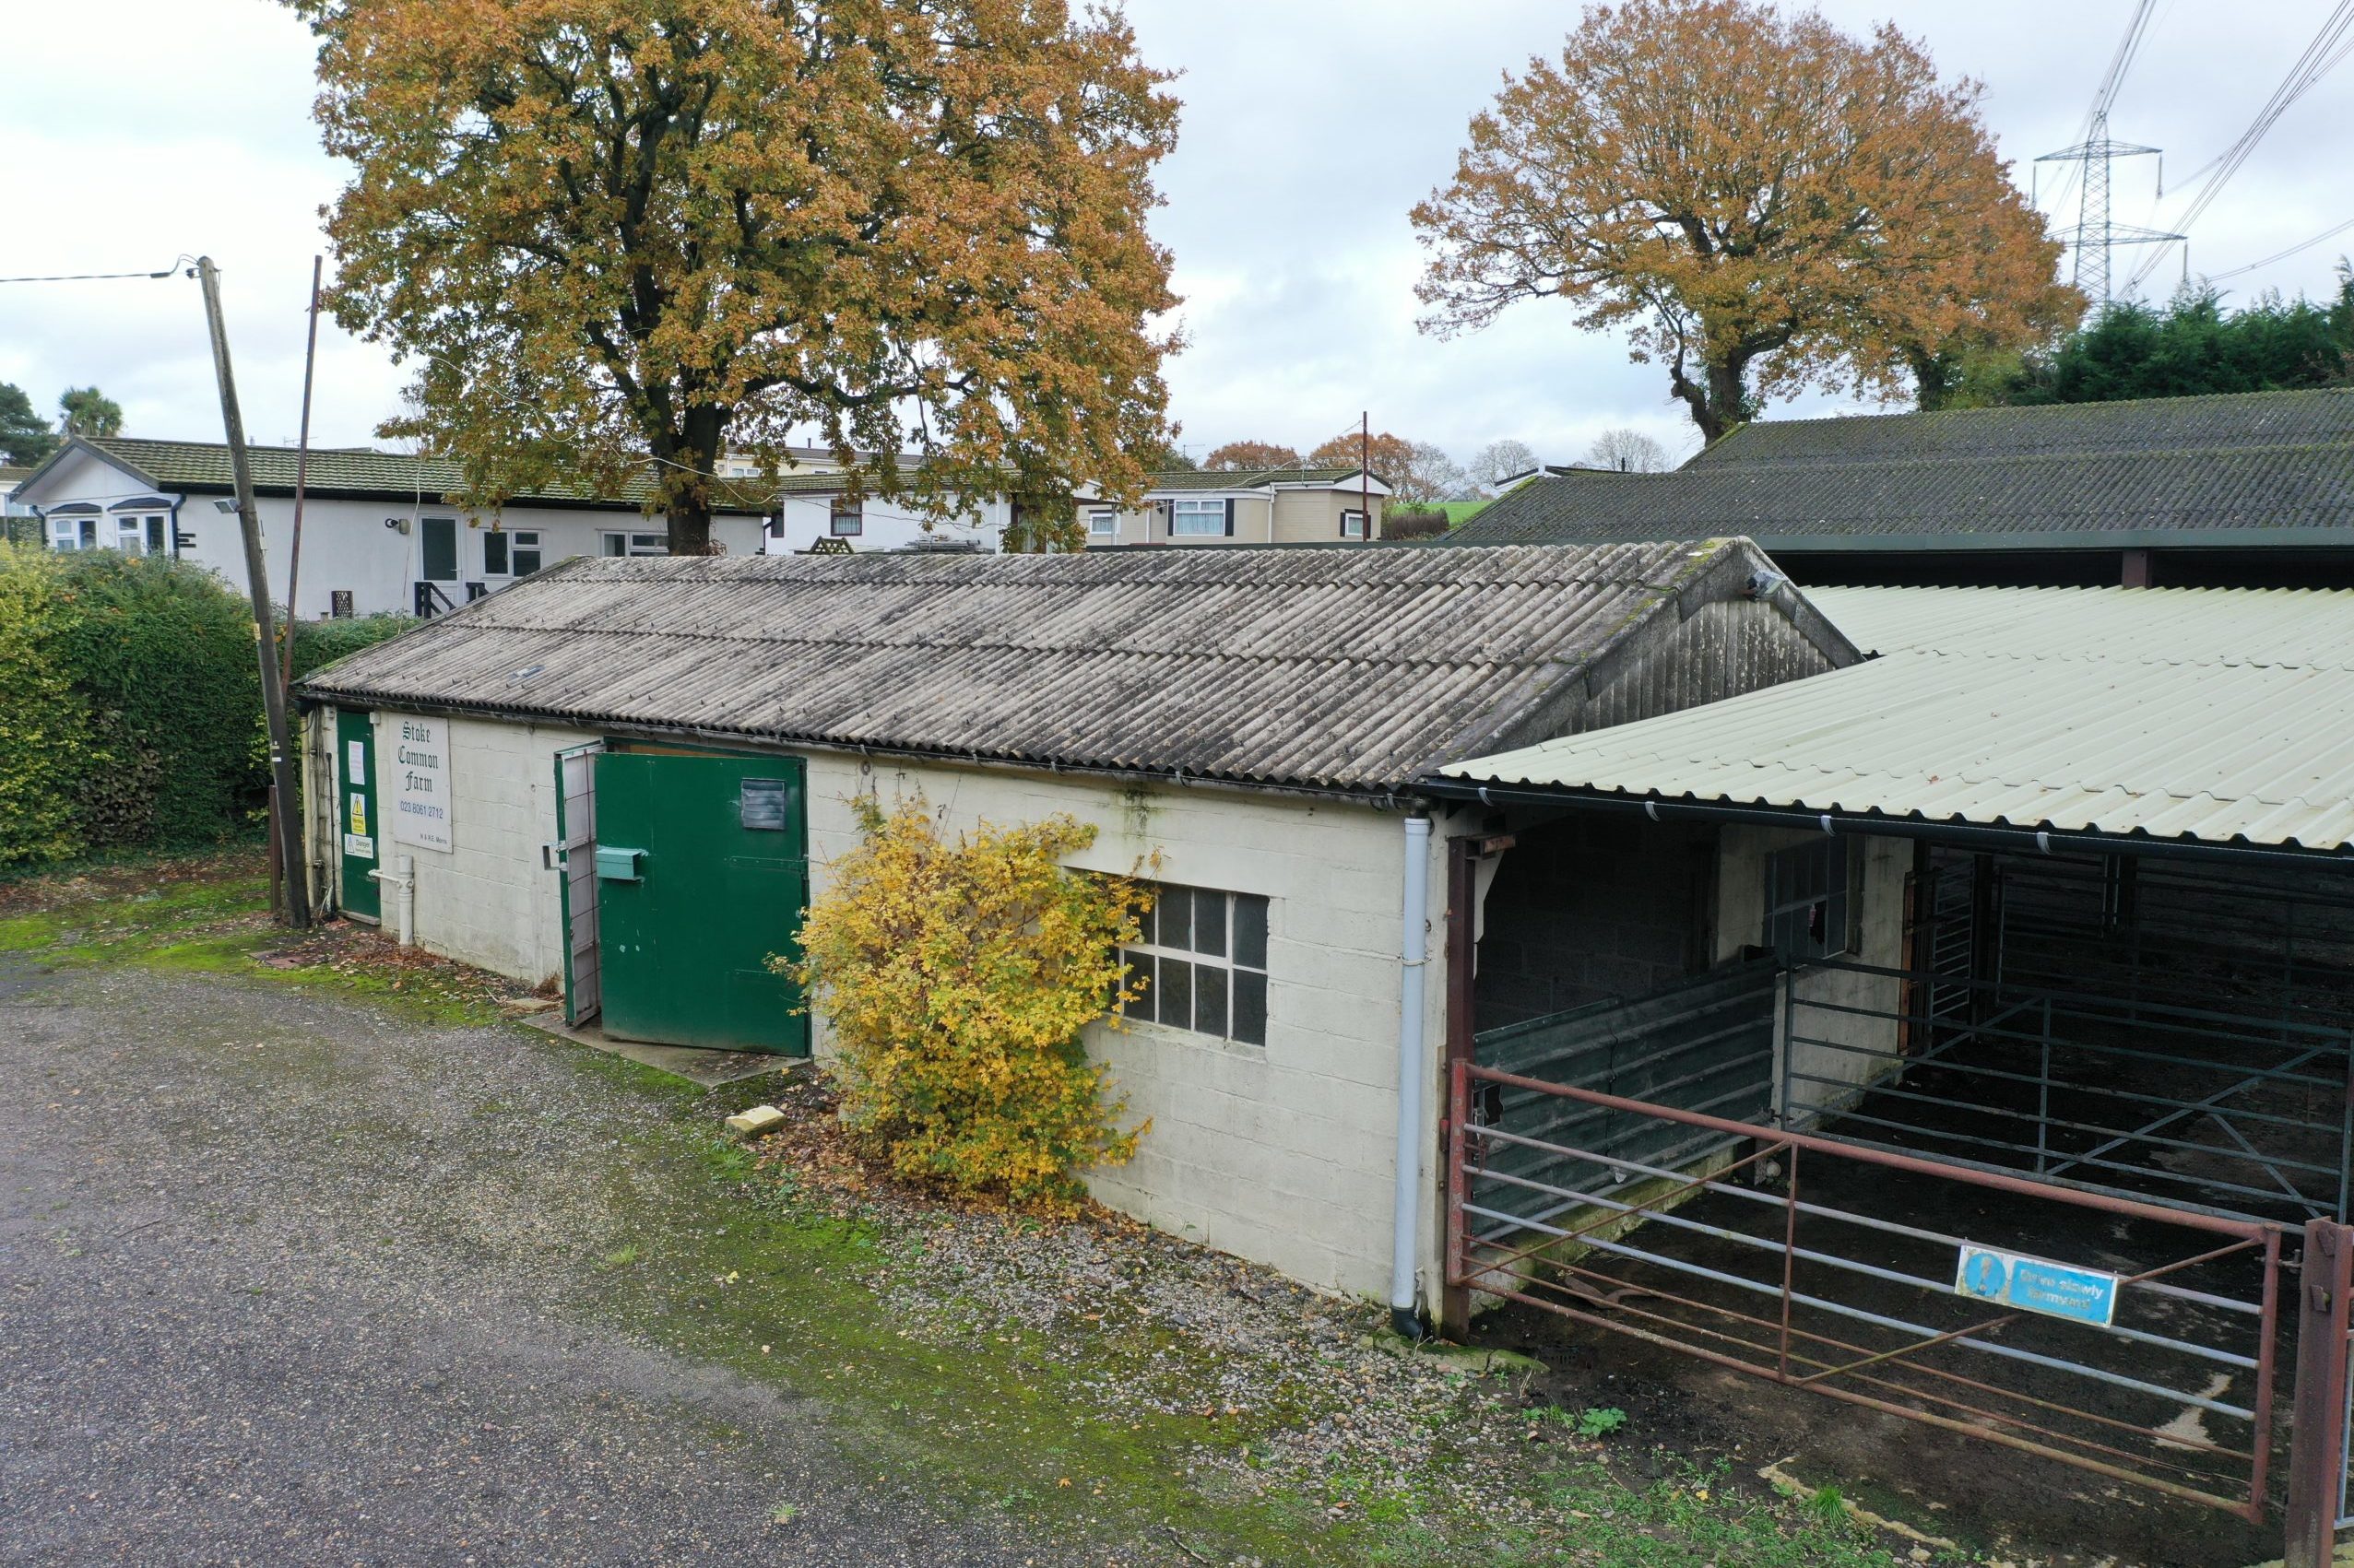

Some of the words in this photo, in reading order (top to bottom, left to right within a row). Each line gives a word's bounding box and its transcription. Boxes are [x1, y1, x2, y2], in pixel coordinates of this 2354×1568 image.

[402, 721, 431, 743] Stoke
[398, 745, 439, 769] Common
[406, 771, 432, 793] Farm
[400, 800, 411, 813] 023
[428, 806, 444, 819] 2712
[356, 838, 371, 849] Danger
[2059, 1279, 2104, 1300] slowly
